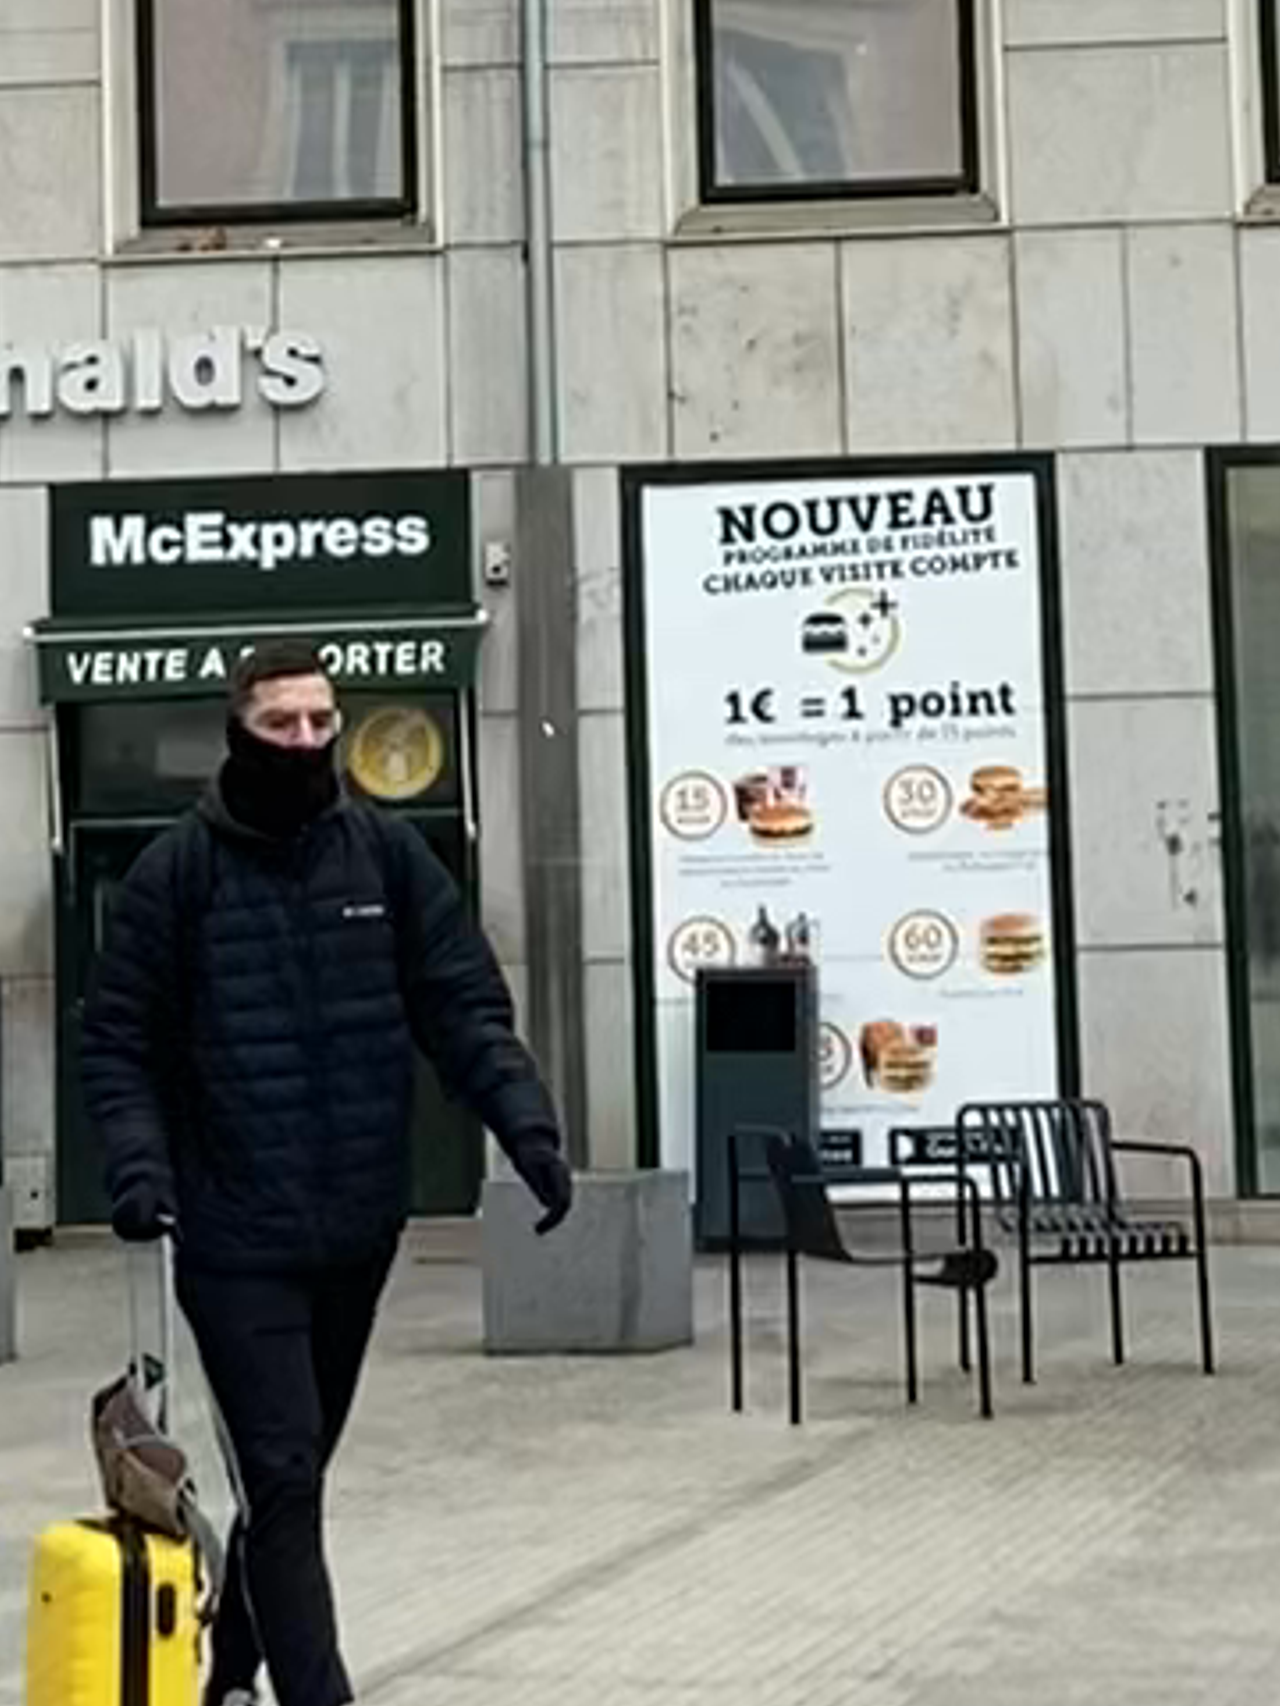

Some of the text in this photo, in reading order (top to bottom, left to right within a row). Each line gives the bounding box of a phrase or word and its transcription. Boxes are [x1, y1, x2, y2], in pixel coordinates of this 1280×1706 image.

[717, 483, 994, 545] NOUVEAU
[90, 512, 430, 570] McExpress
[723, 537, 859, 566] PROGRAMME
[866, 536, 894, 553] DE
[703, 548, 1019, 595] CHAQUE VISITE COMPTE
[67, 649, 188, 684] VENTE
[239, 641, 445, 678] ORTER
[724, 687, 776, 725] 1€
[841, 685, 864, 720] 1
[887, 681, 1016, 728] point
[904, 923, 942, 951] 60
